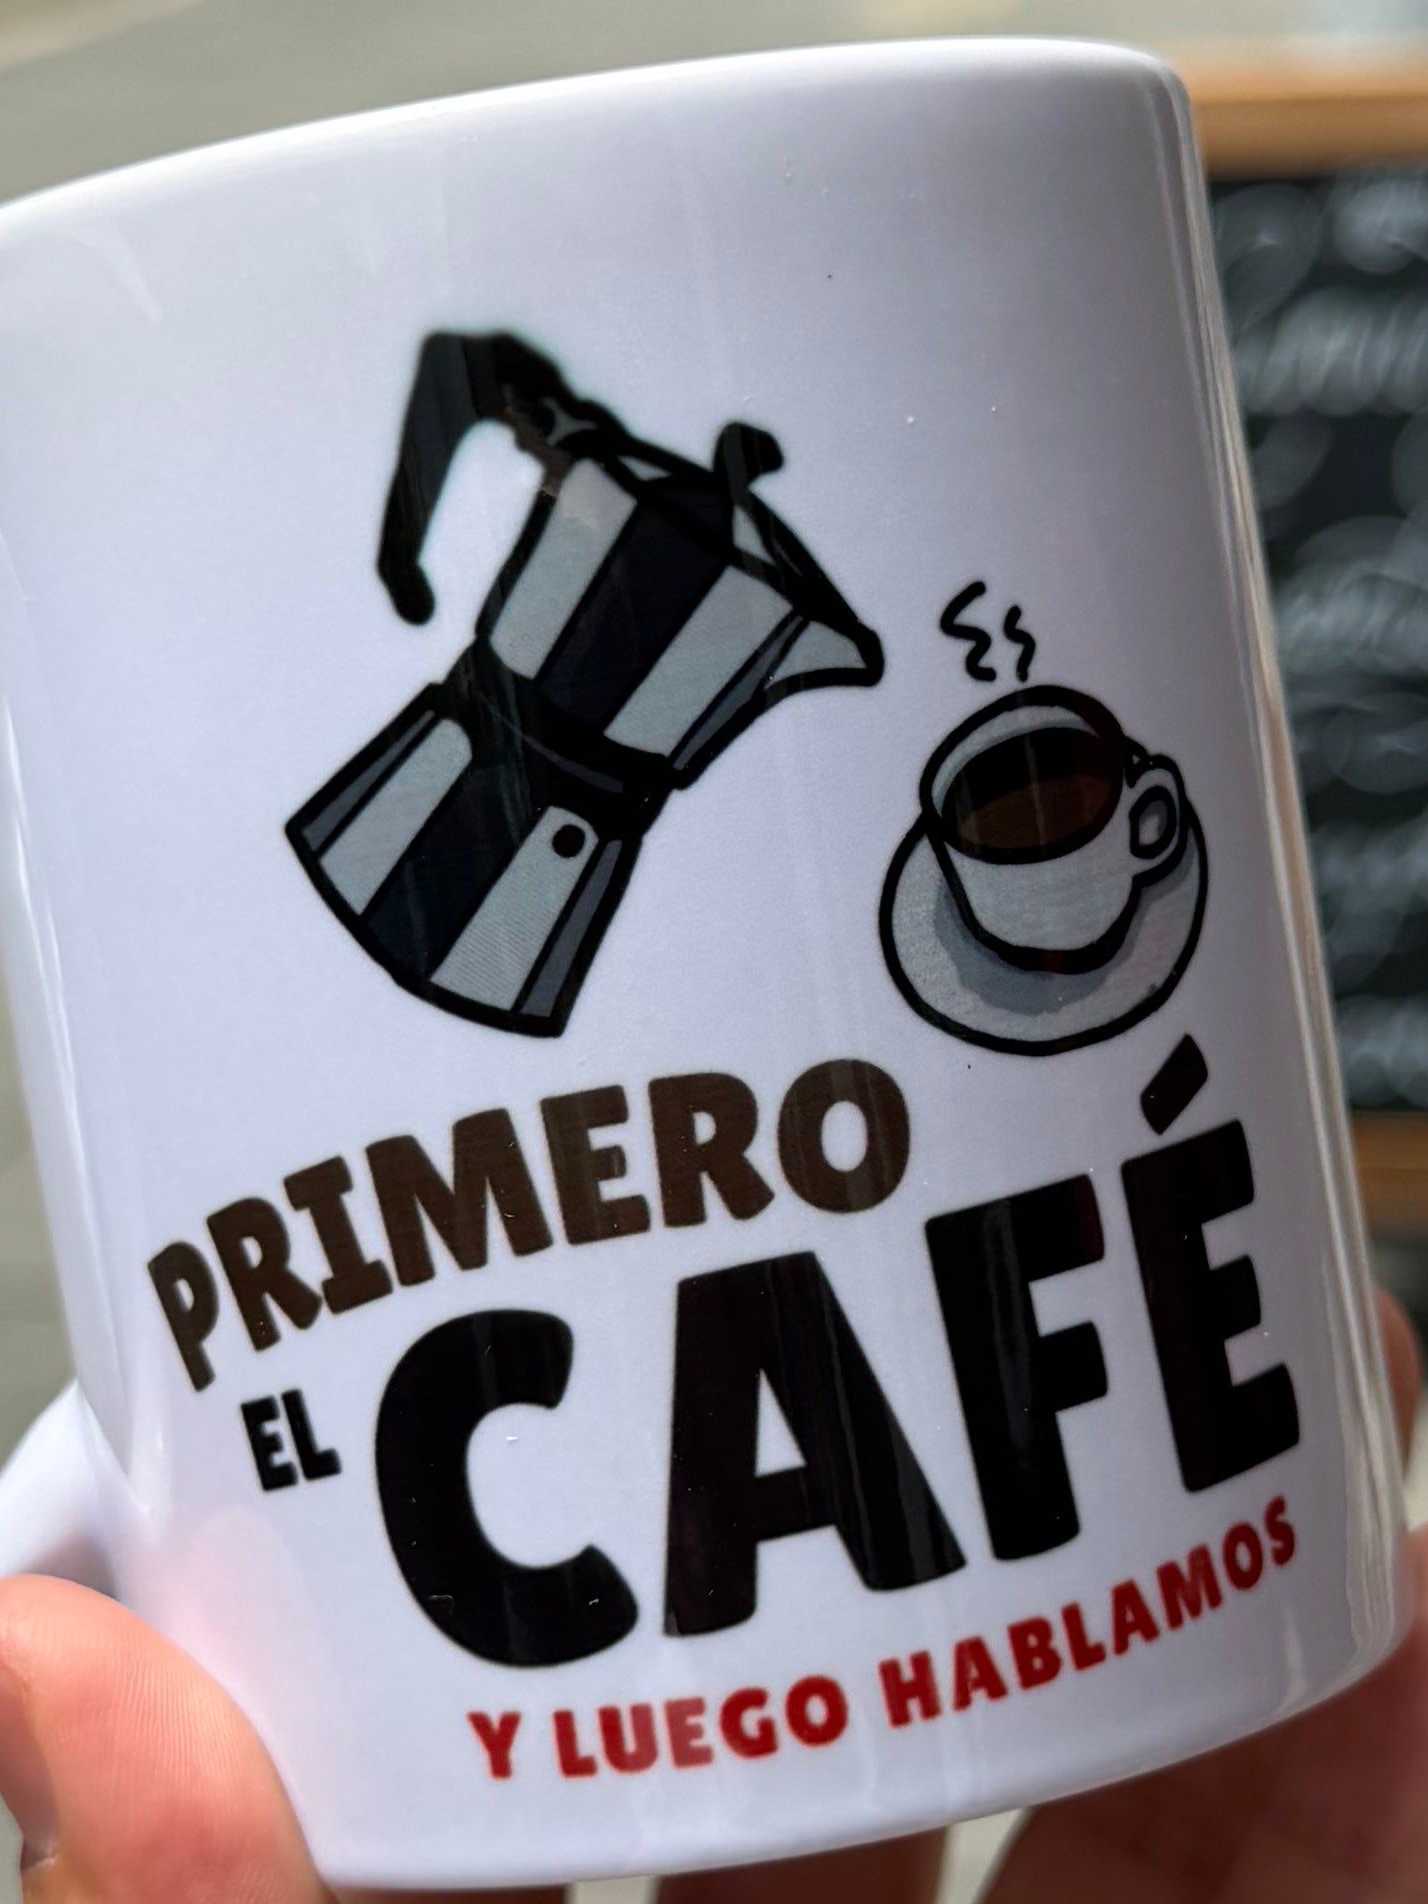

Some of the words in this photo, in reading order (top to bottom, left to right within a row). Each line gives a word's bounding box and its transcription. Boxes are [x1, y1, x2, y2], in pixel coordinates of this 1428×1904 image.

[146, 1058, 912, 1391] PRIMERO
[240, 1387, 342, 1492] EL
[374, 1034, 1301, 1670] CAFÉ
[468, 1709, 522, 1780] Y
[553, 1674, 849, 1779] LUEGO
[878, 1495, 1298, 1728] HABLAMOS
